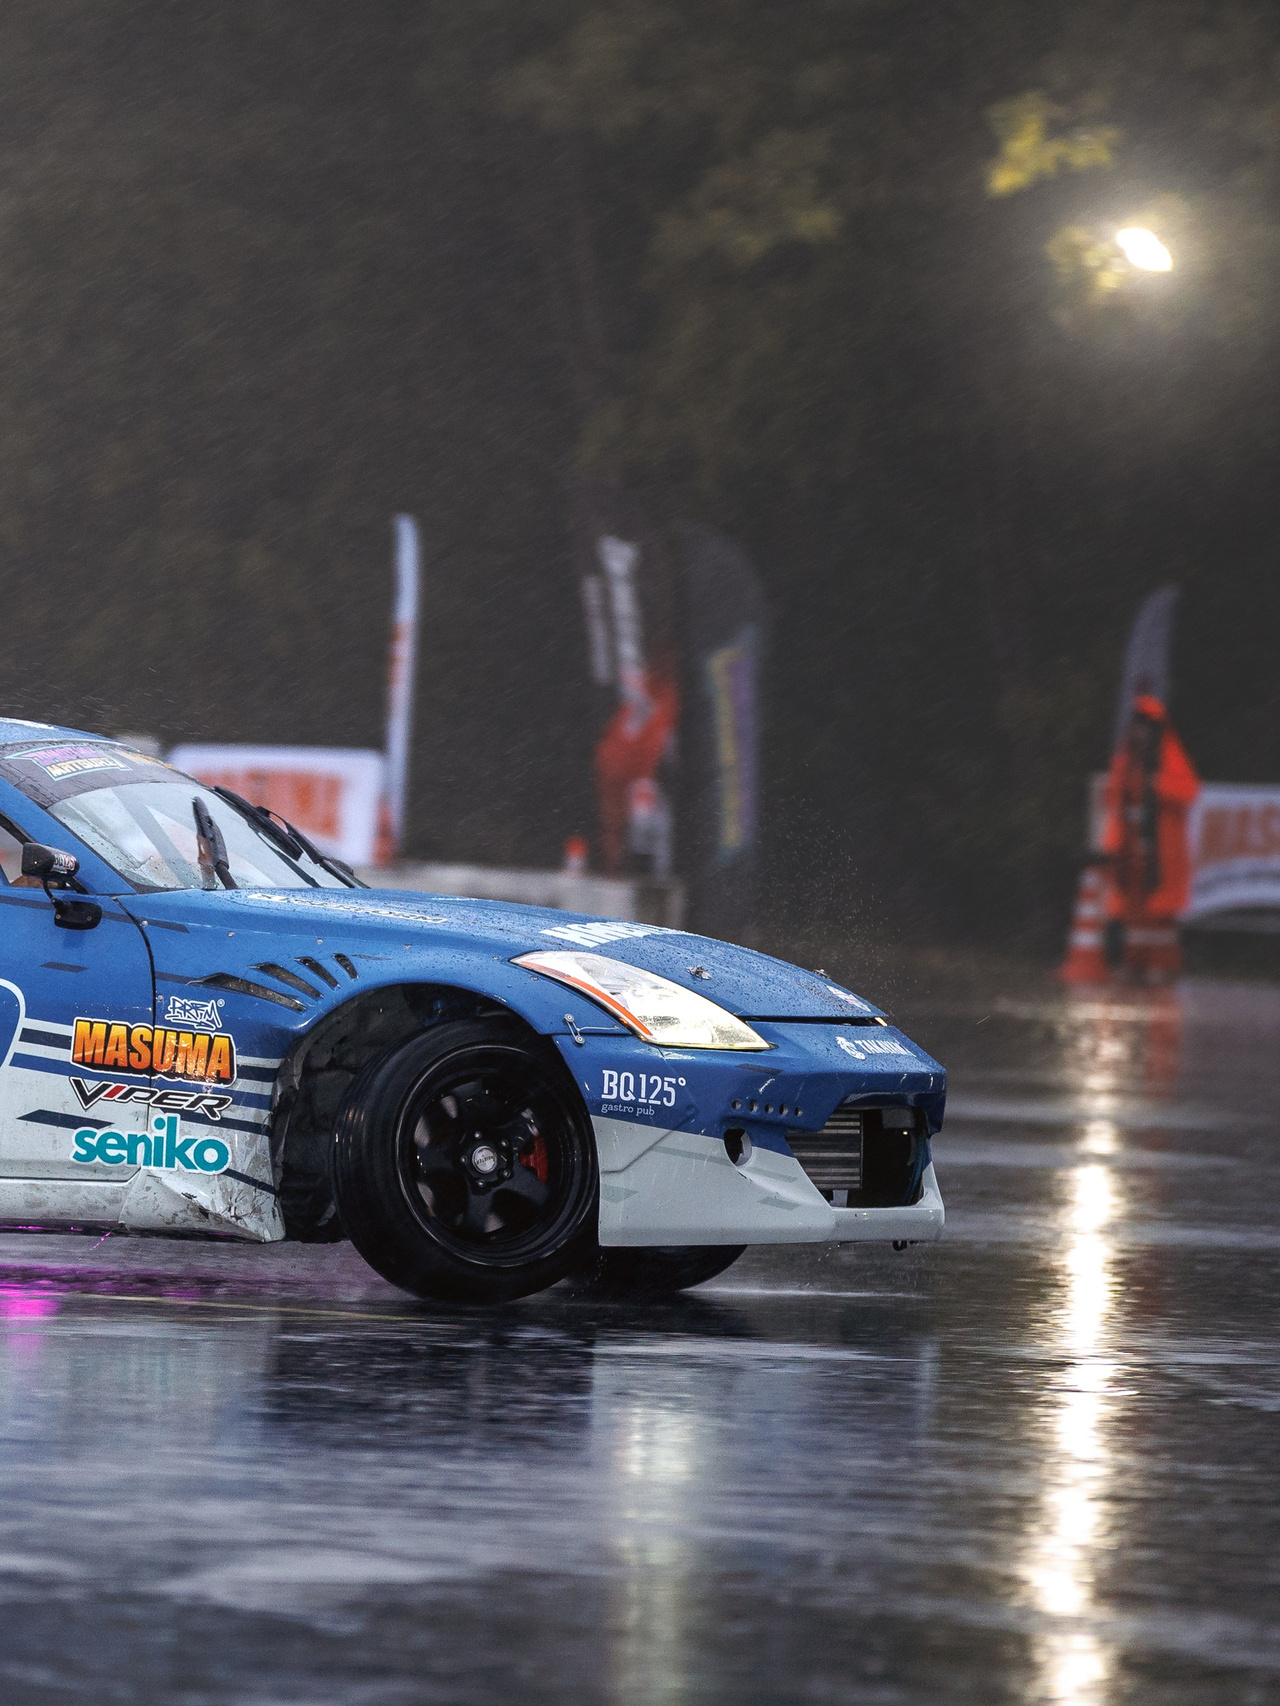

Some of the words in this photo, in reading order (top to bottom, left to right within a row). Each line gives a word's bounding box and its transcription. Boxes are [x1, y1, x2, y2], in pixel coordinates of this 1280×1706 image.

[72, 1019, 233, 1082] MASUMA
[70, 1077, 232, 1120] VIPER
[601, 1103, 634, 1114] gastro
[636, 1105, 655, 1117] pub
[72, 1115, 229, 1173] seniko
